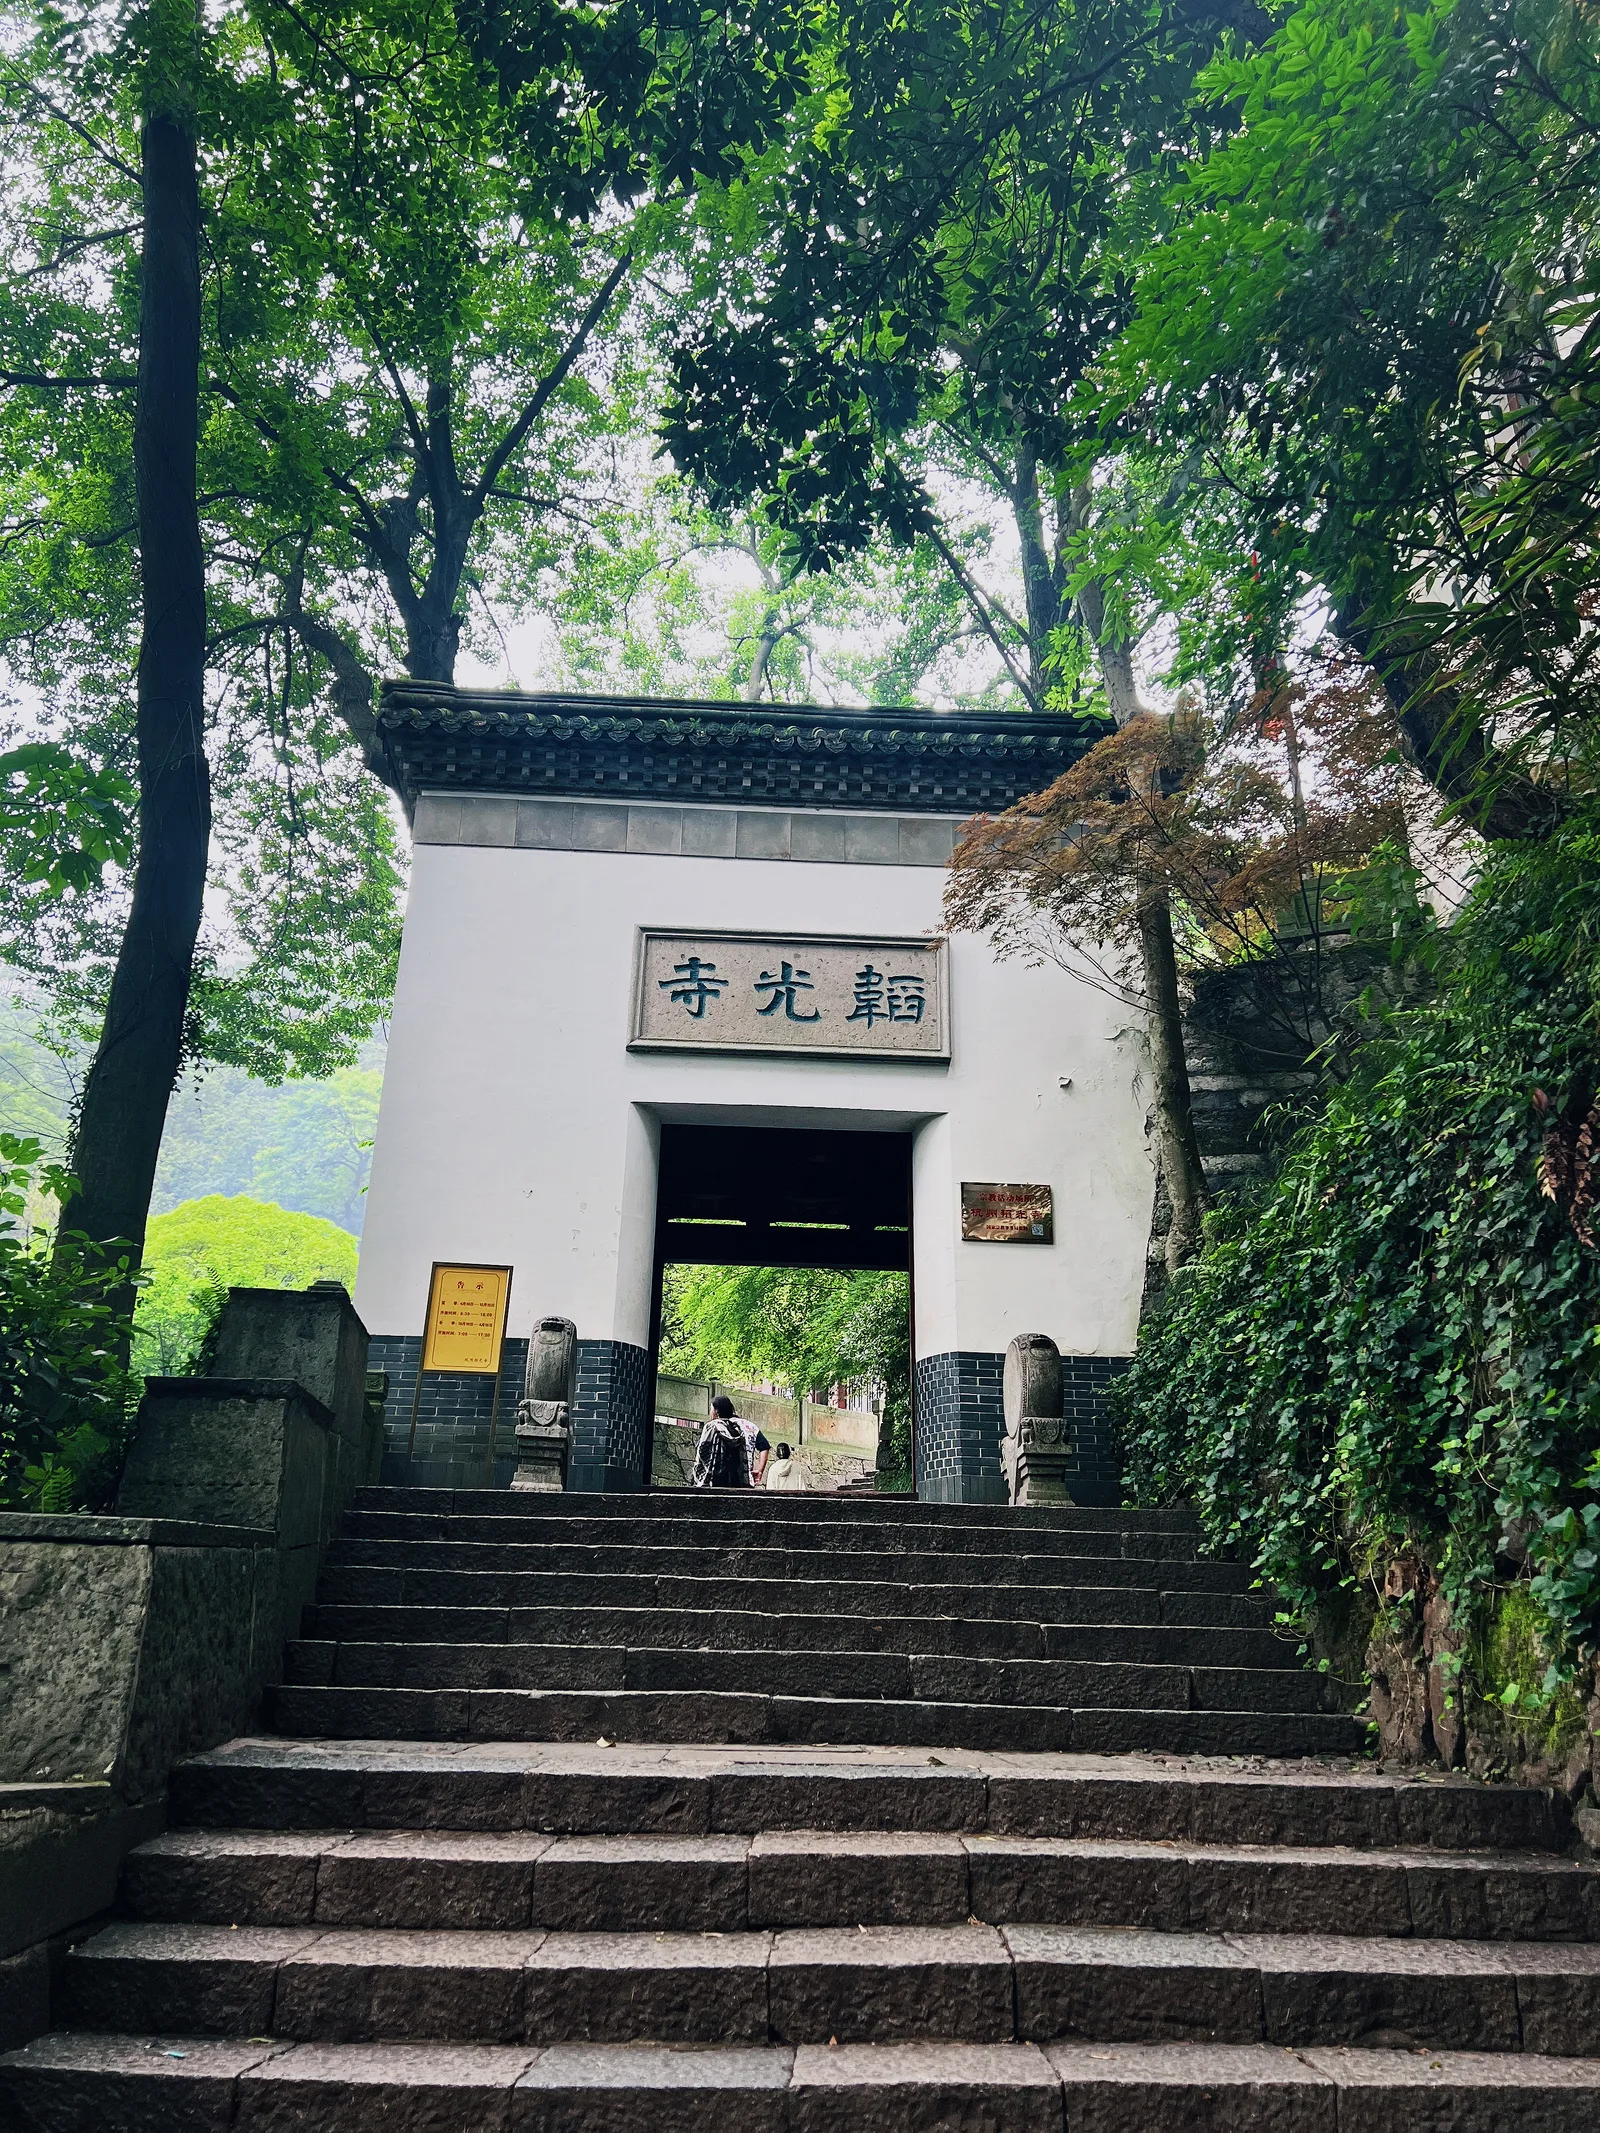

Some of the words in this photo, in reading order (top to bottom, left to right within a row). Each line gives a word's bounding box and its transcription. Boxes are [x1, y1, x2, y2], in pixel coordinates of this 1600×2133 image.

[979, 1193, 1033, 1203] 宗教活动场所
